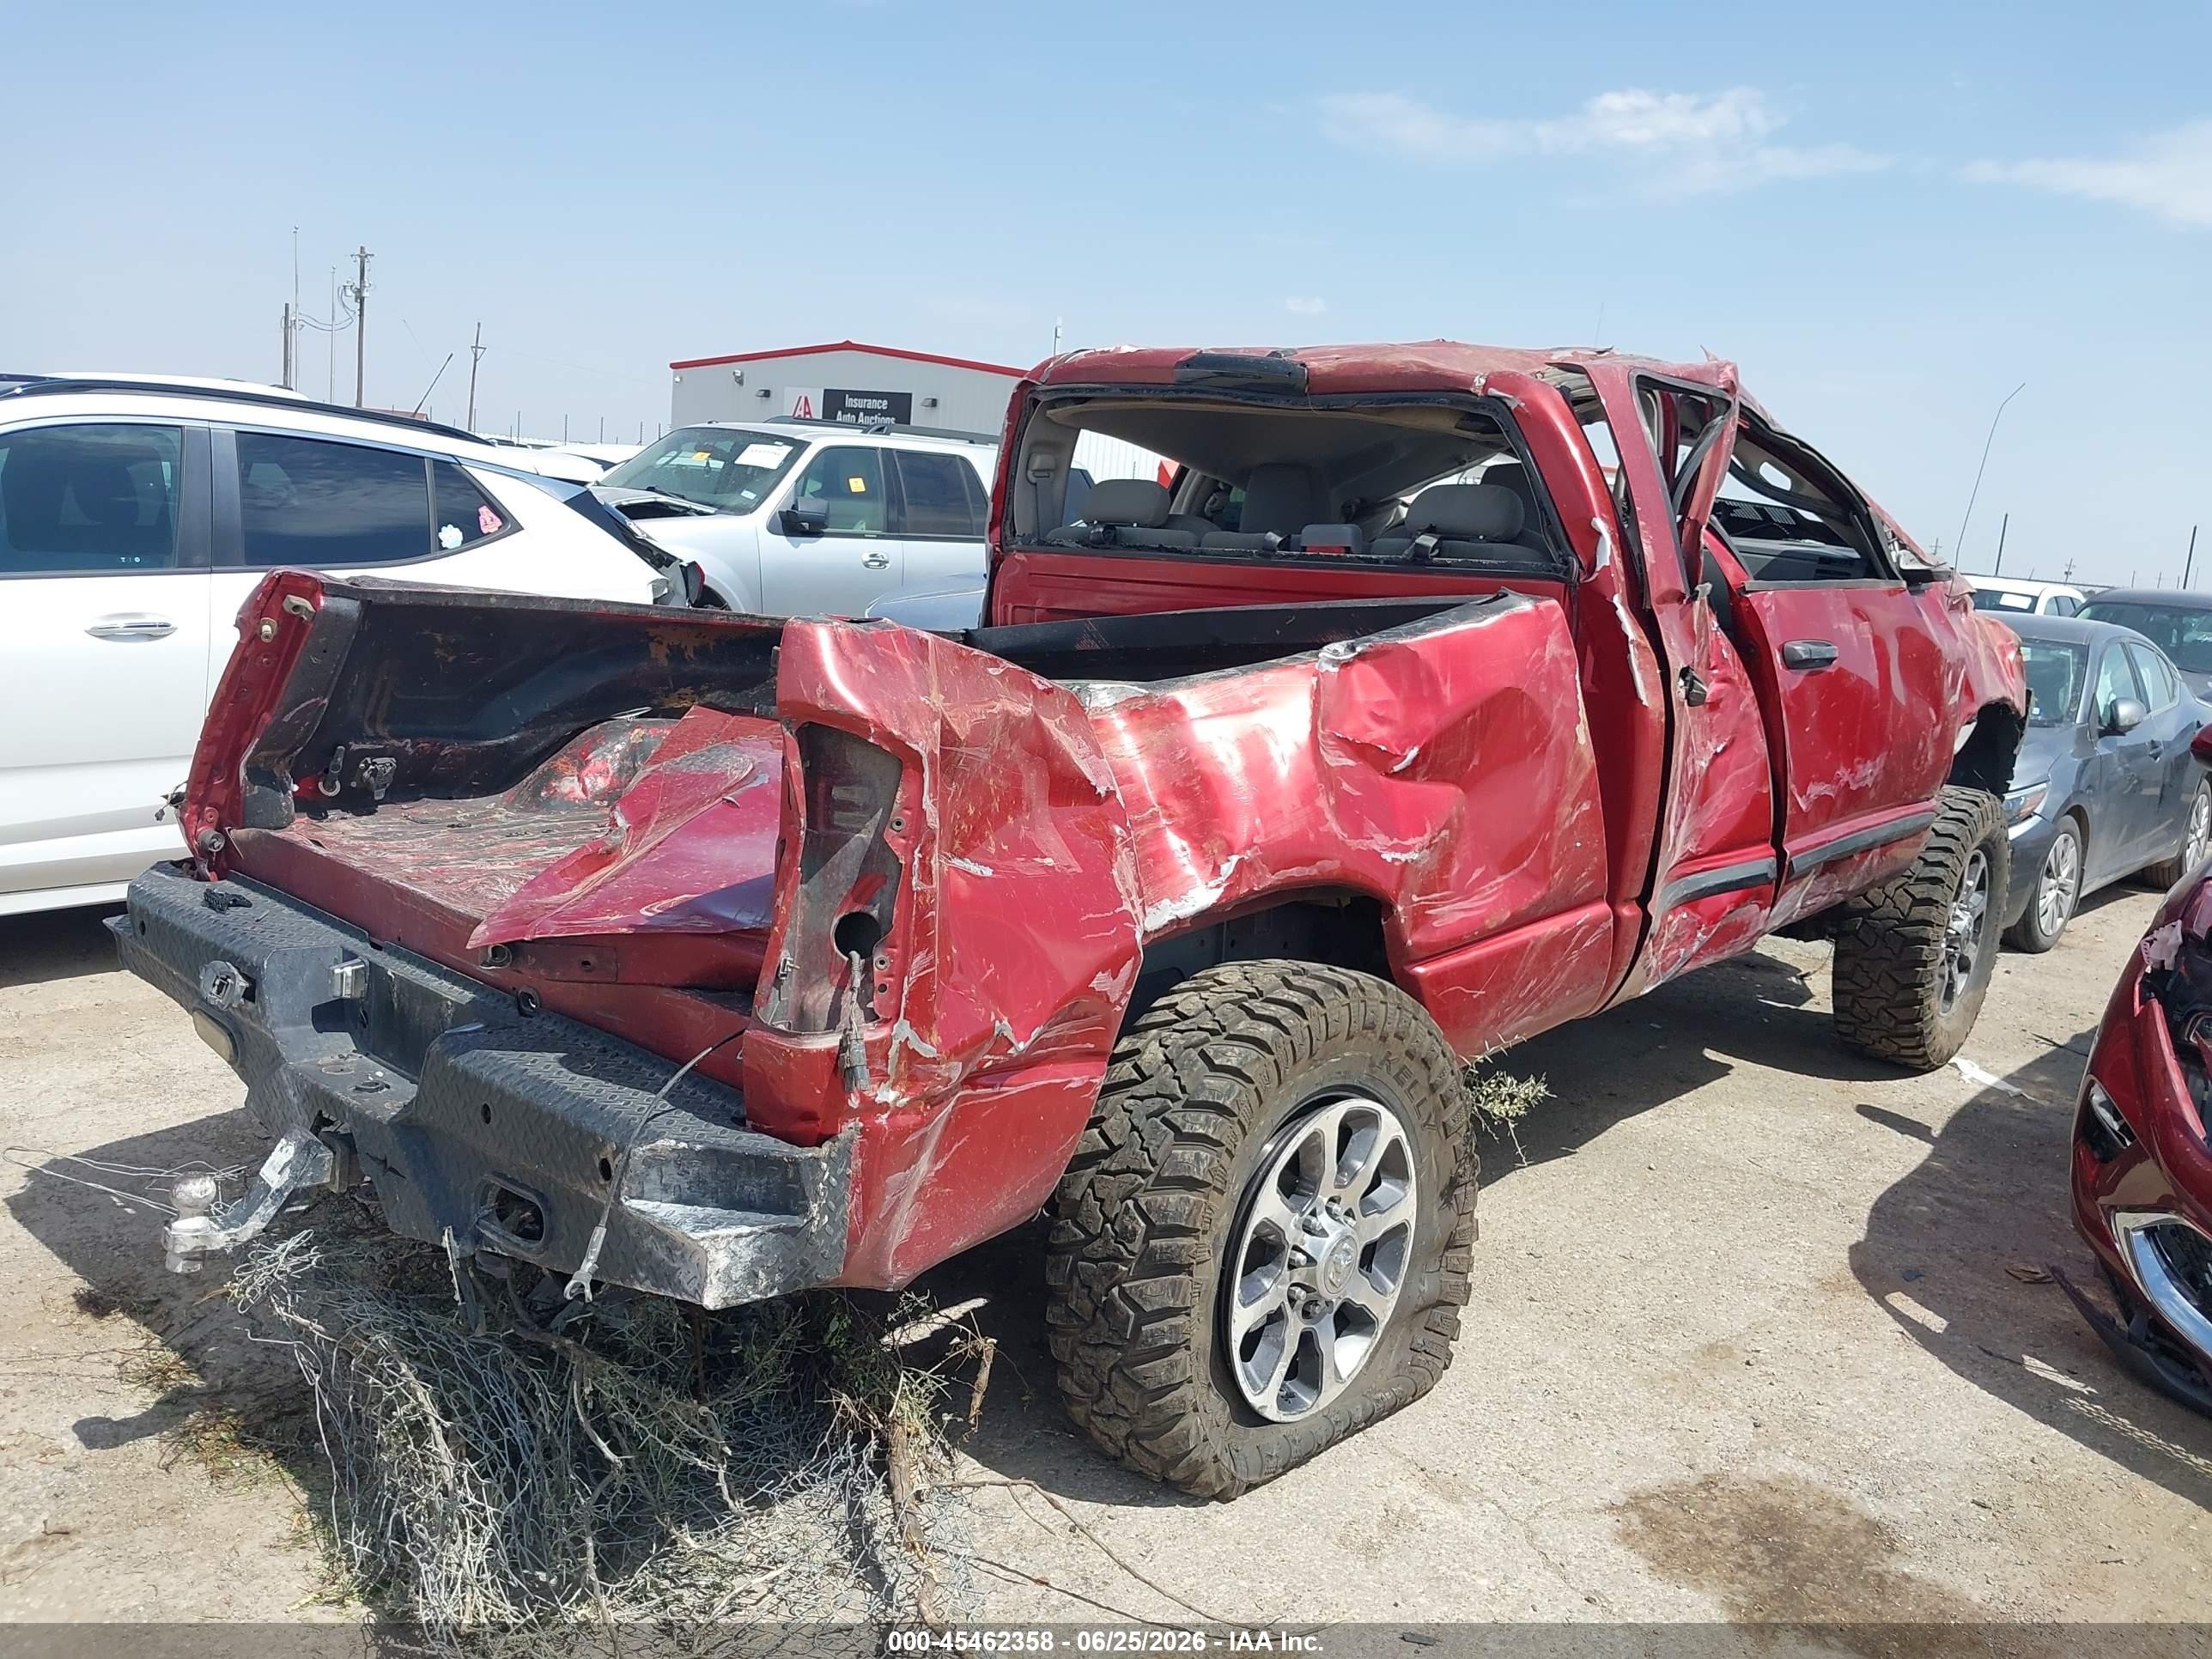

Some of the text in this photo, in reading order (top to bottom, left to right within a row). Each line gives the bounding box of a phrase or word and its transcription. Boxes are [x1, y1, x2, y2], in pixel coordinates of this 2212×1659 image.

[845, 394, 888, 410] Insurance
[836, 410, 896, 426] Auto Auctions
[1378, 1050, 1437, 1131] KELLY
